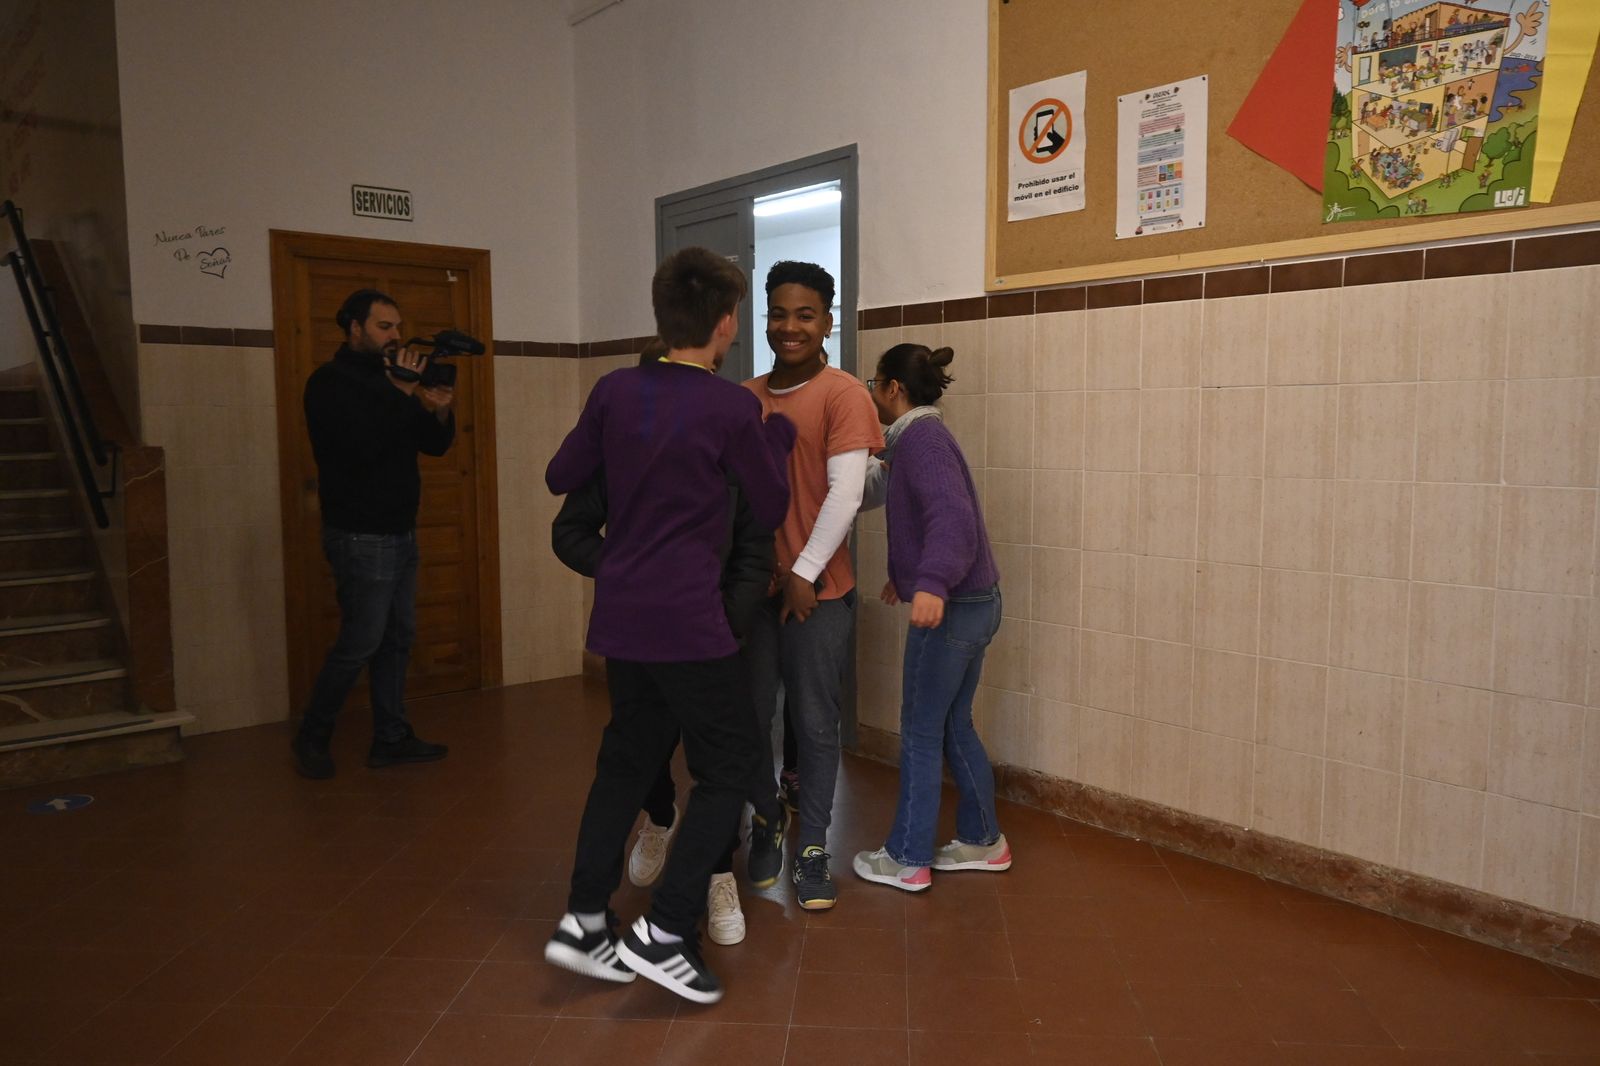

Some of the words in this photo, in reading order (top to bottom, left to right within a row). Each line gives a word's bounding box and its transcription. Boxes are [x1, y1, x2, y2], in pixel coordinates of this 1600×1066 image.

[1018, 178, 1050, 189] Prohibido
[1052, 175, 1067, 183] usar
[1068, 172, 1076, 180] el
[1014, 193, 1033, 201] móvil
[1053, 184, 1080, 195] edificio
[356, 190, 410, 216] SERVICIOS
[153, 230, 192, 247] Nunca
